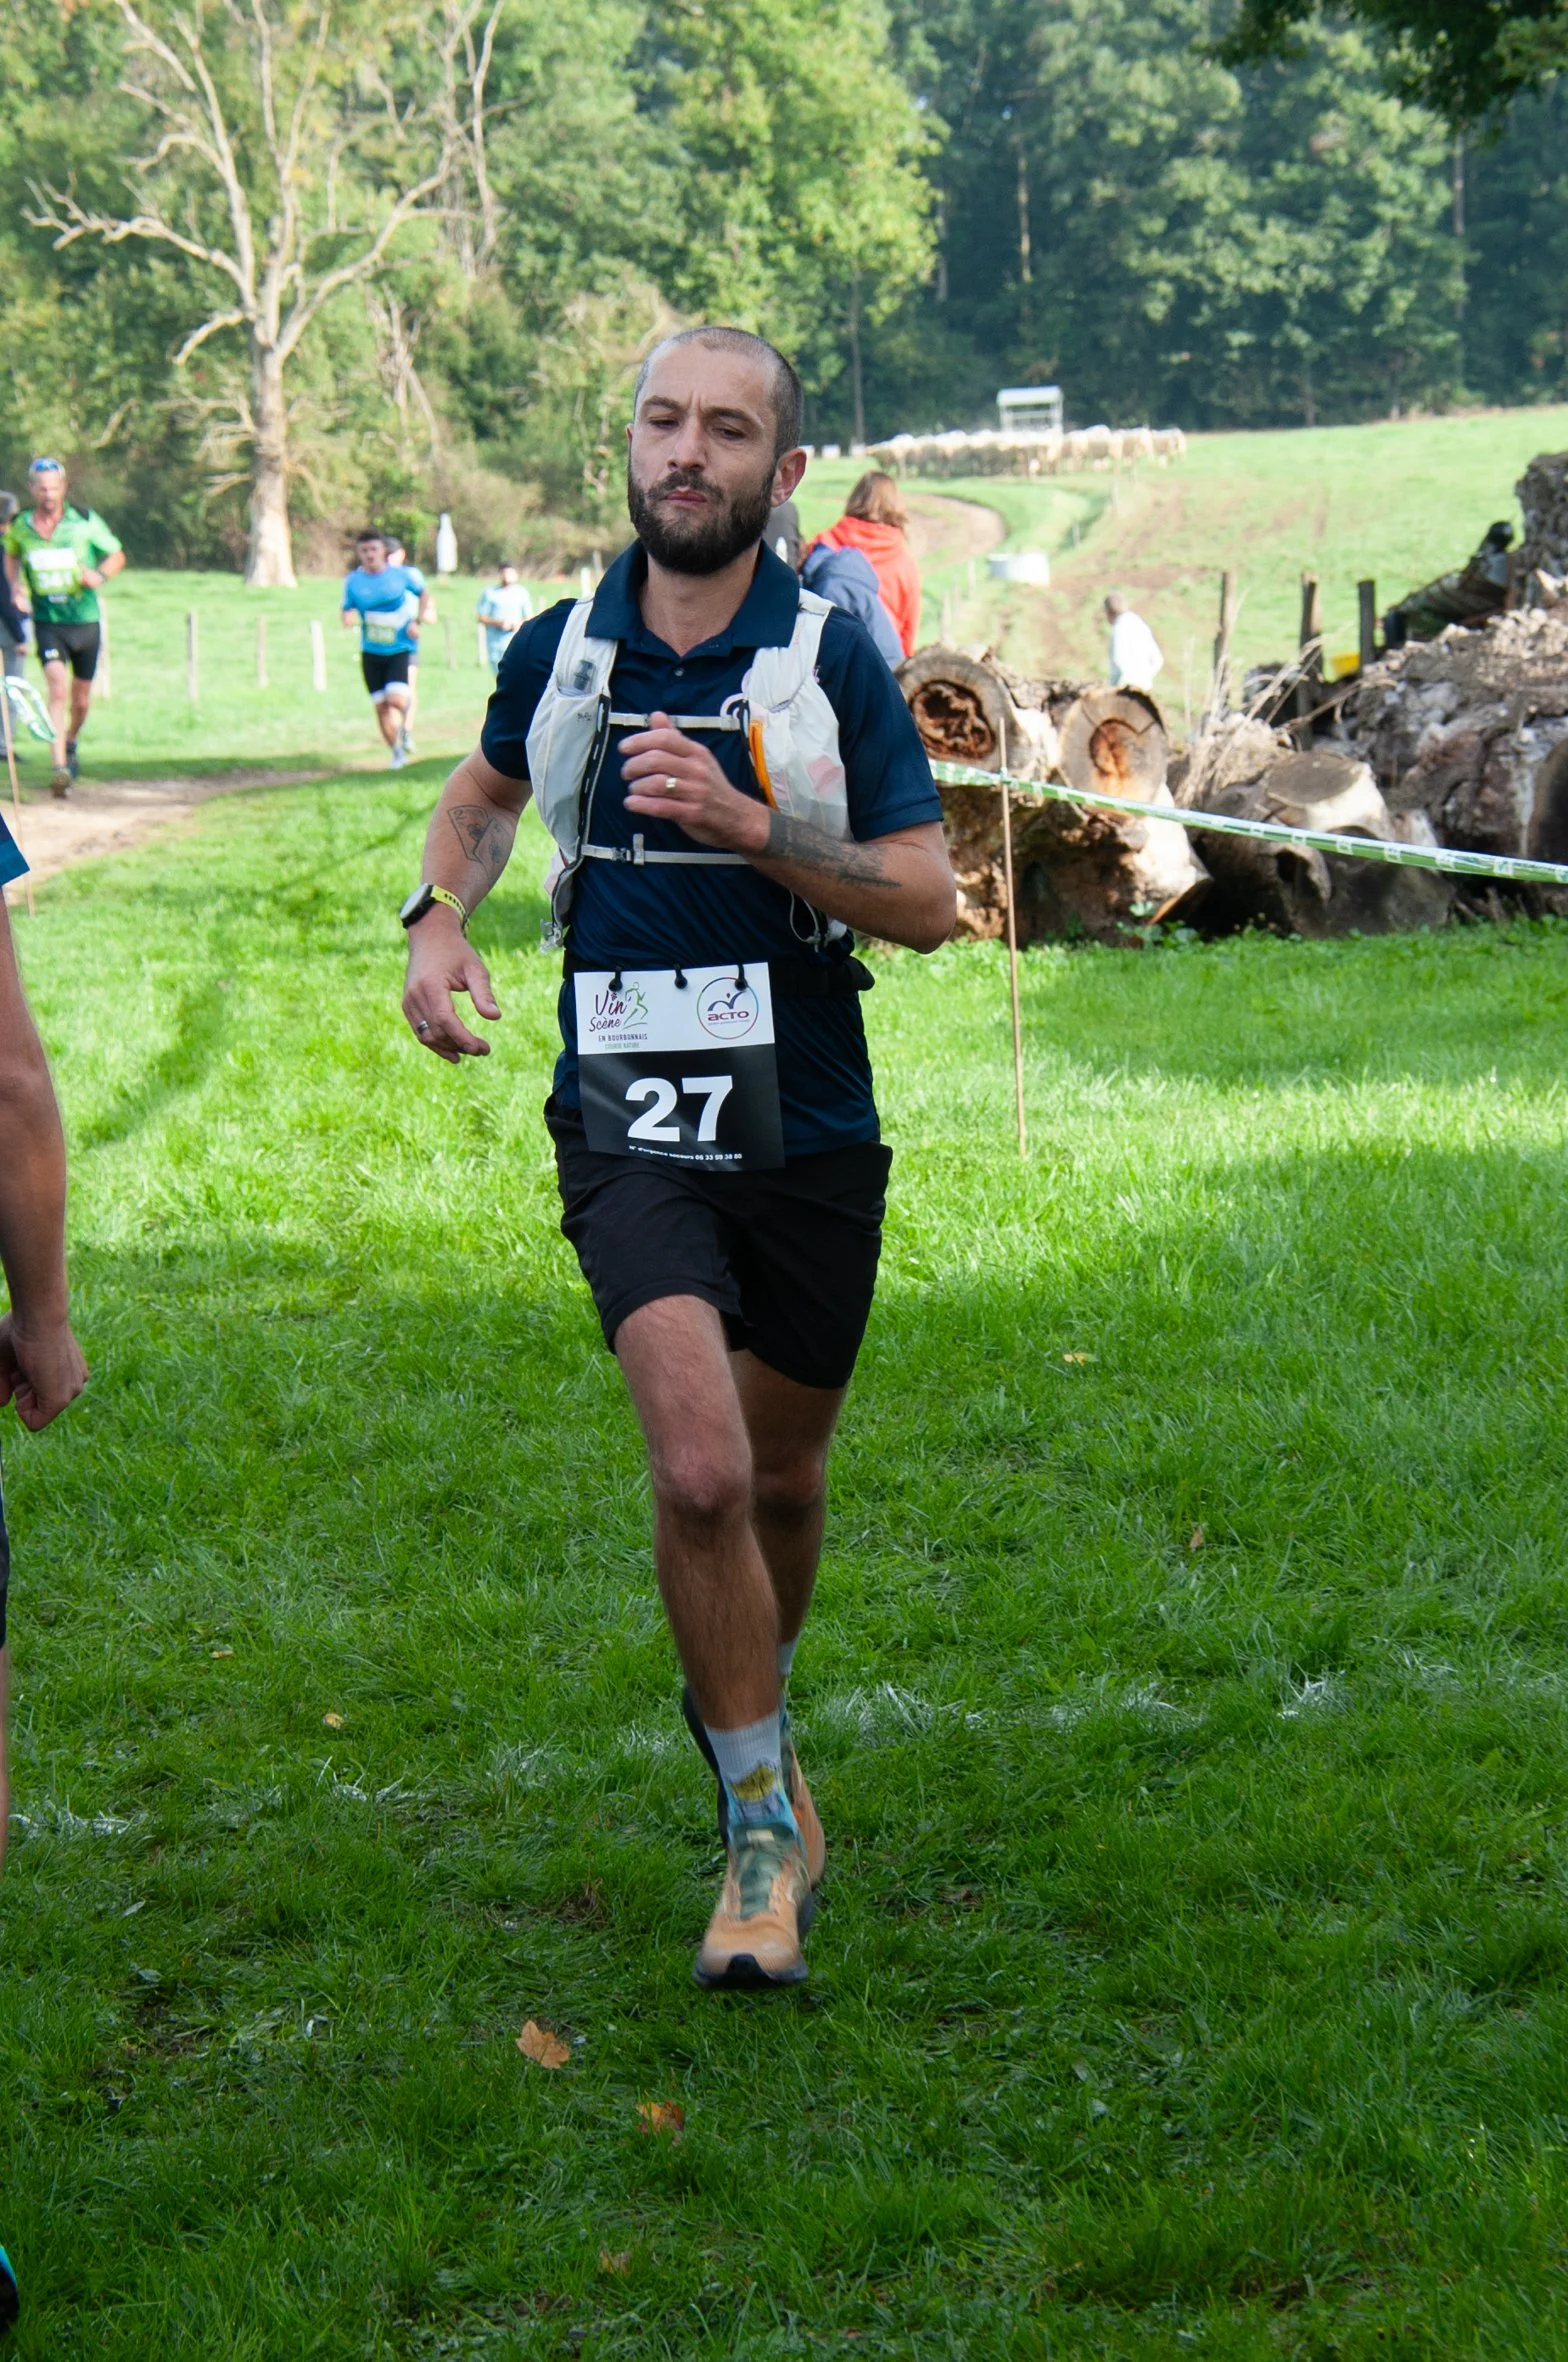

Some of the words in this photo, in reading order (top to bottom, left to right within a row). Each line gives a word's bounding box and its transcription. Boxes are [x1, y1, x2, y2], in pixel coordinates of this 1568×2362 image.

[589, 1016, 622, 1032] Scène
[607, 1033, 648, 1042] BOURBONNAIS
[625, 1075, 733, 1142] 27
